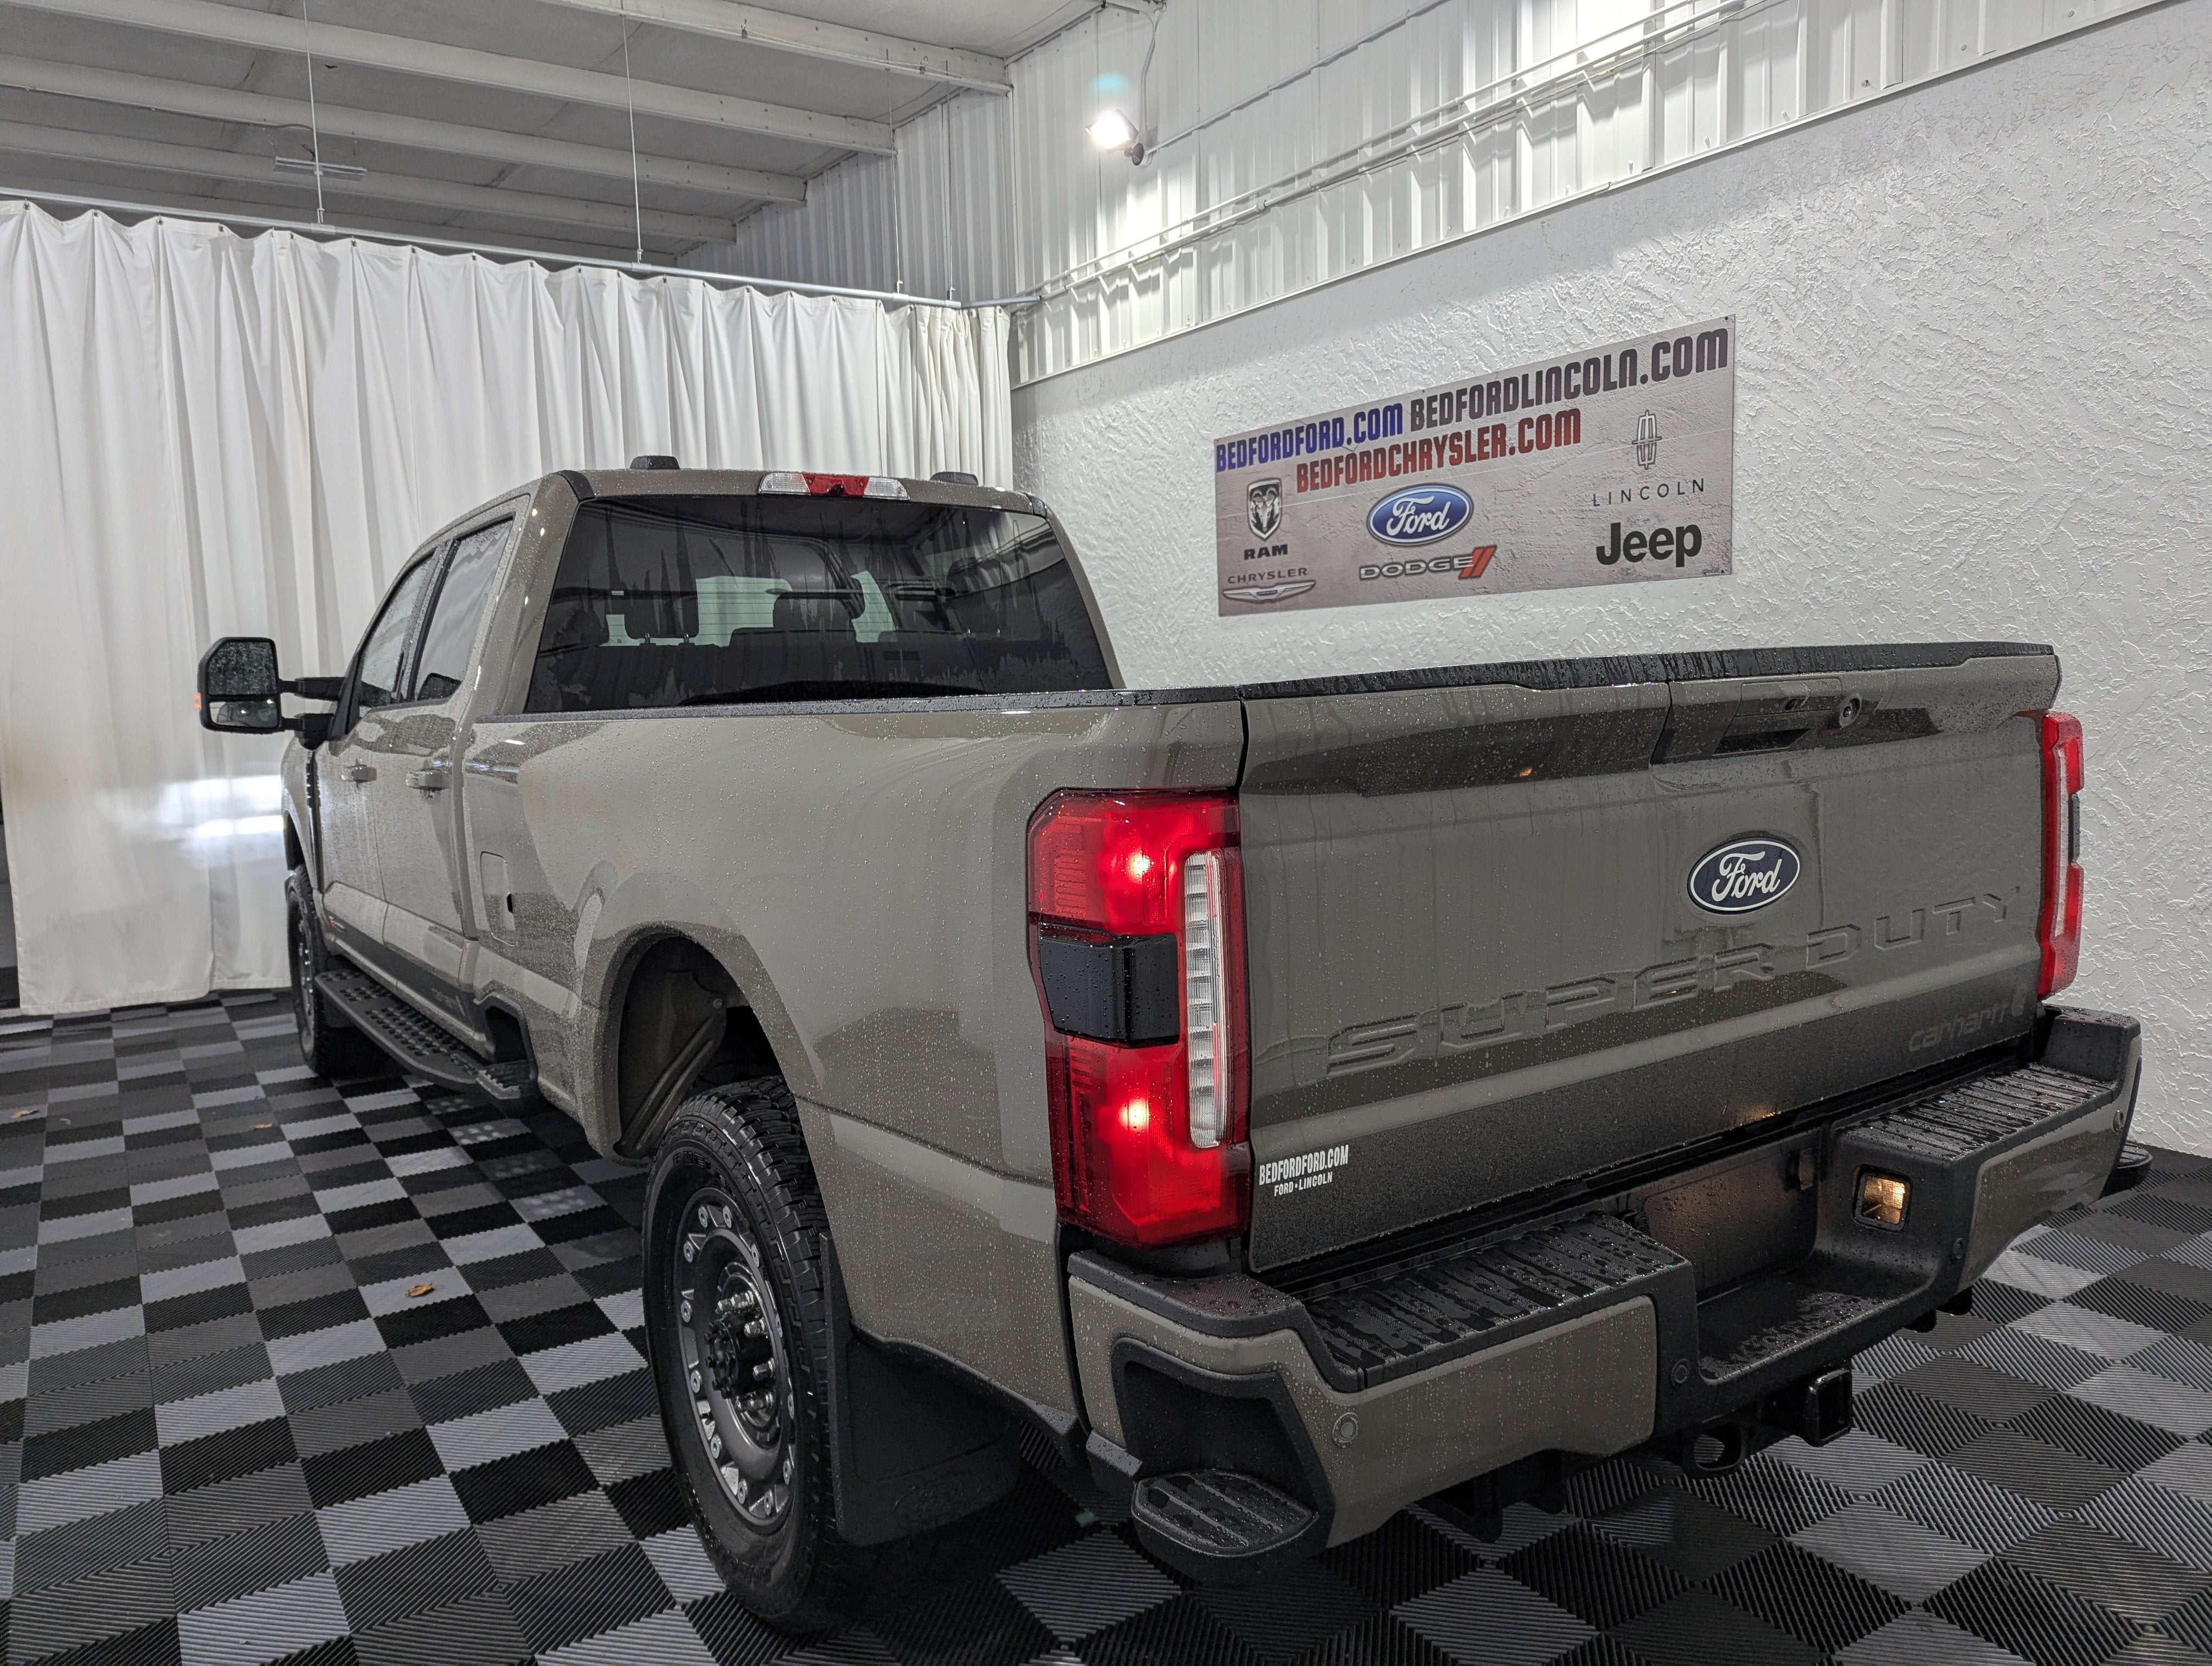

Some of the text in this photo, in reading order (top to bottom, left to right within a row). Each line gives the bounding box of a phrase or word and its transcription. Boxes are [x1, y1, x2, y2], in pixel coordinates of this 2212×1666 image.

[1216, 328, 1728, 472] BEDFORDFORD.COM BEDFORDLINCOLN.COM
[1297, 408, 1581, 494] BEDFORDCHRYSLER.COM
[1593, 478, 1704, 507] LINCOLN
[1386, 495, 1452, 536] Ford
[1244, 544, 1288, 561] RAM
[1596, 522, 1702, 568] Jeep
[1227, 567, 1308, 584] CHRYSLER
[1359, 554, 1474, 580] DODGE
[1711, 851, 1783, 902] Ford
[1326, 886, 2021, 1078] SUPER DUTY
[1259, 1144, 1349, 1186] BEDFORDFORD.COM
[1274, 1171, 1333, 1197] FORD LINCOLN
